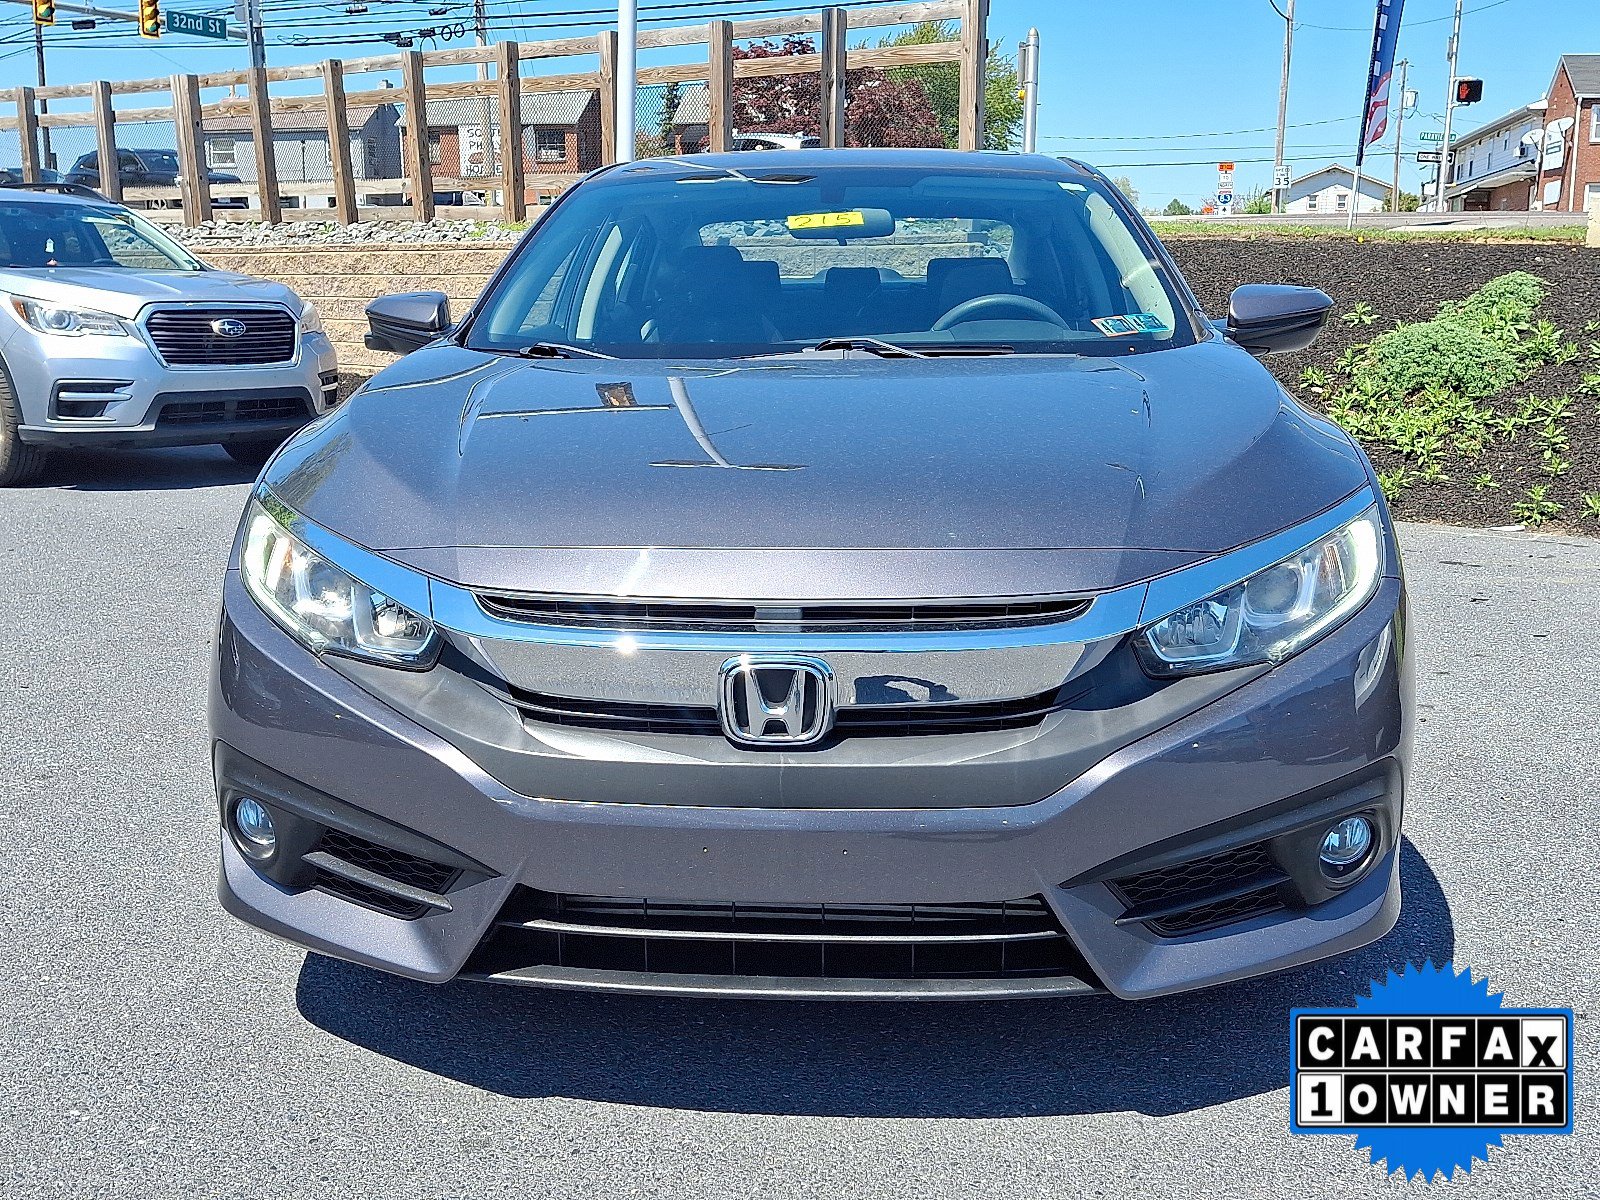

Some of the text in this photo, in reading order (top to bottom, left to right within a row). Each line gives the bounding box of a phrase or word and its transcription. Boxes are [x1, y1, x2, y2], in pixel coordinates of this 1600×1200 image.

[172, 14, 221, 34] 32nd St
[1275, 177, 1290, 187] 35
